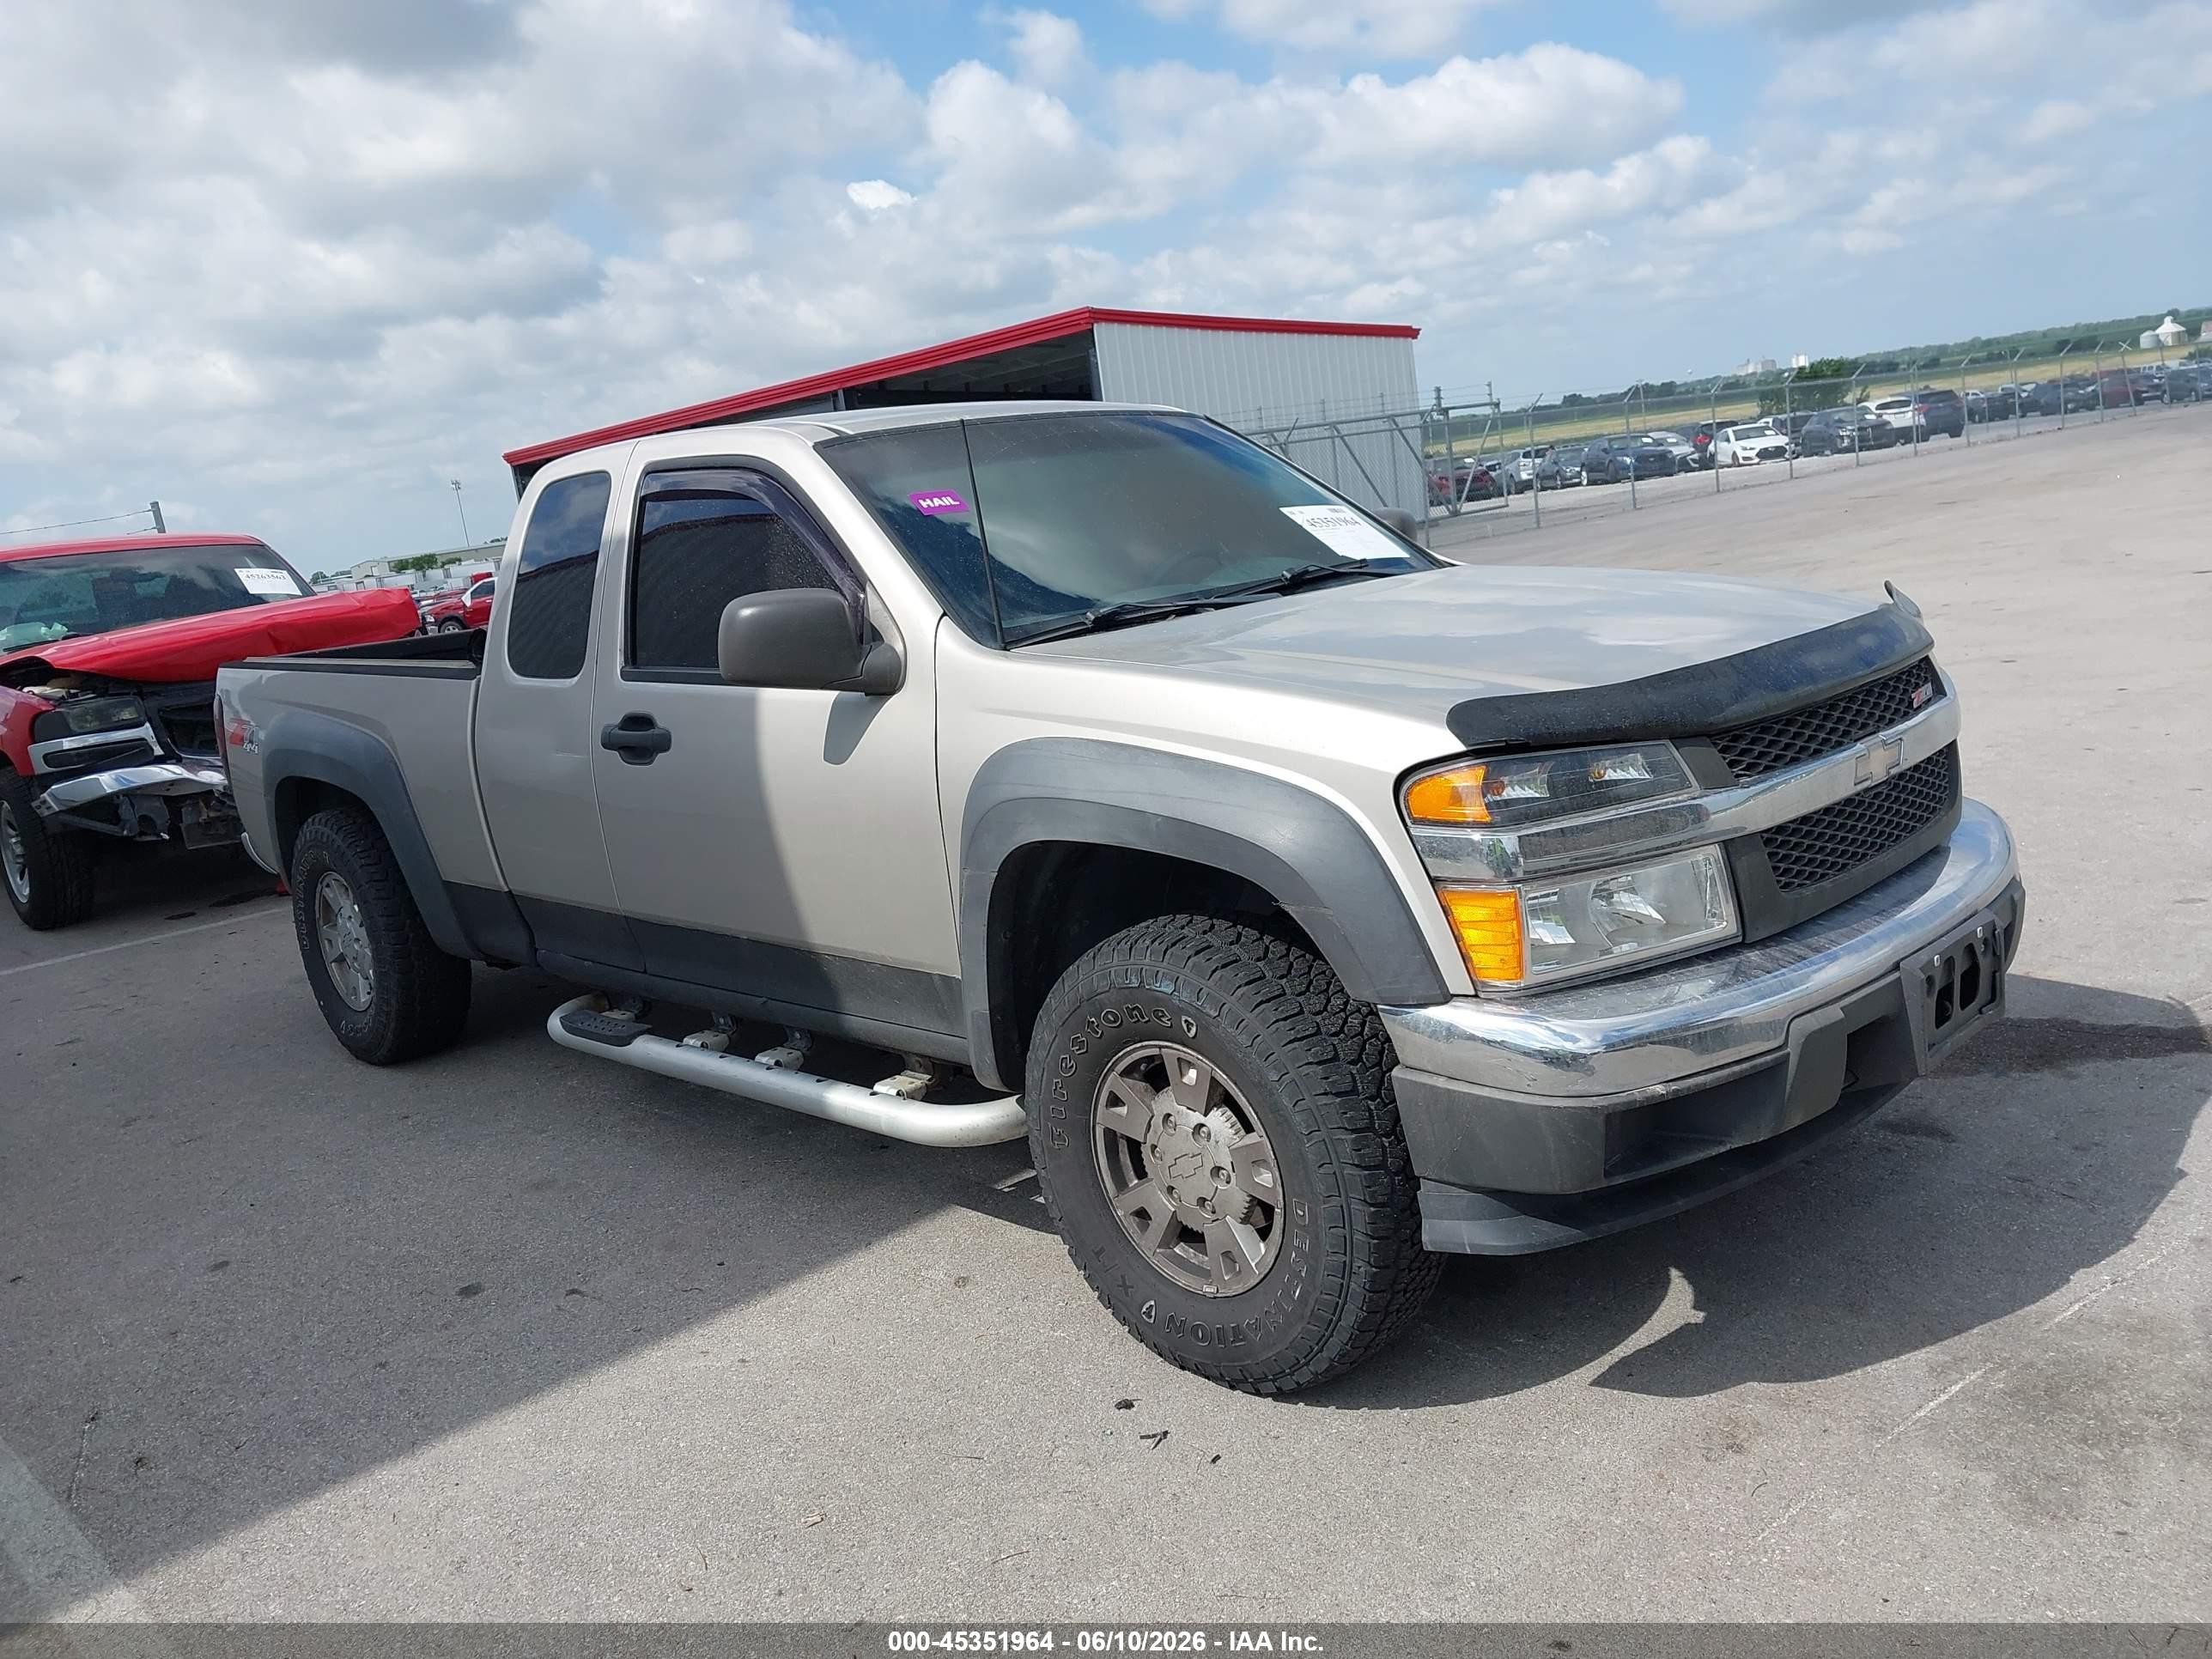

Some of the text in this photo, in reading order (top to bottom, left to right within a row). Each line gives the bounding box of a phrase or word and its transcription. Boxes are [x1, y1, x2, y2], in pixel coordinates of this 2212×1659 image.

[918, 496, 960, 508] HAIL
[1304, 517, 1362, 528] 45351964
[1048, 1003, 1173, 1149] Firestone
[1164, 1198, 1309, 1348] DESTINATION
